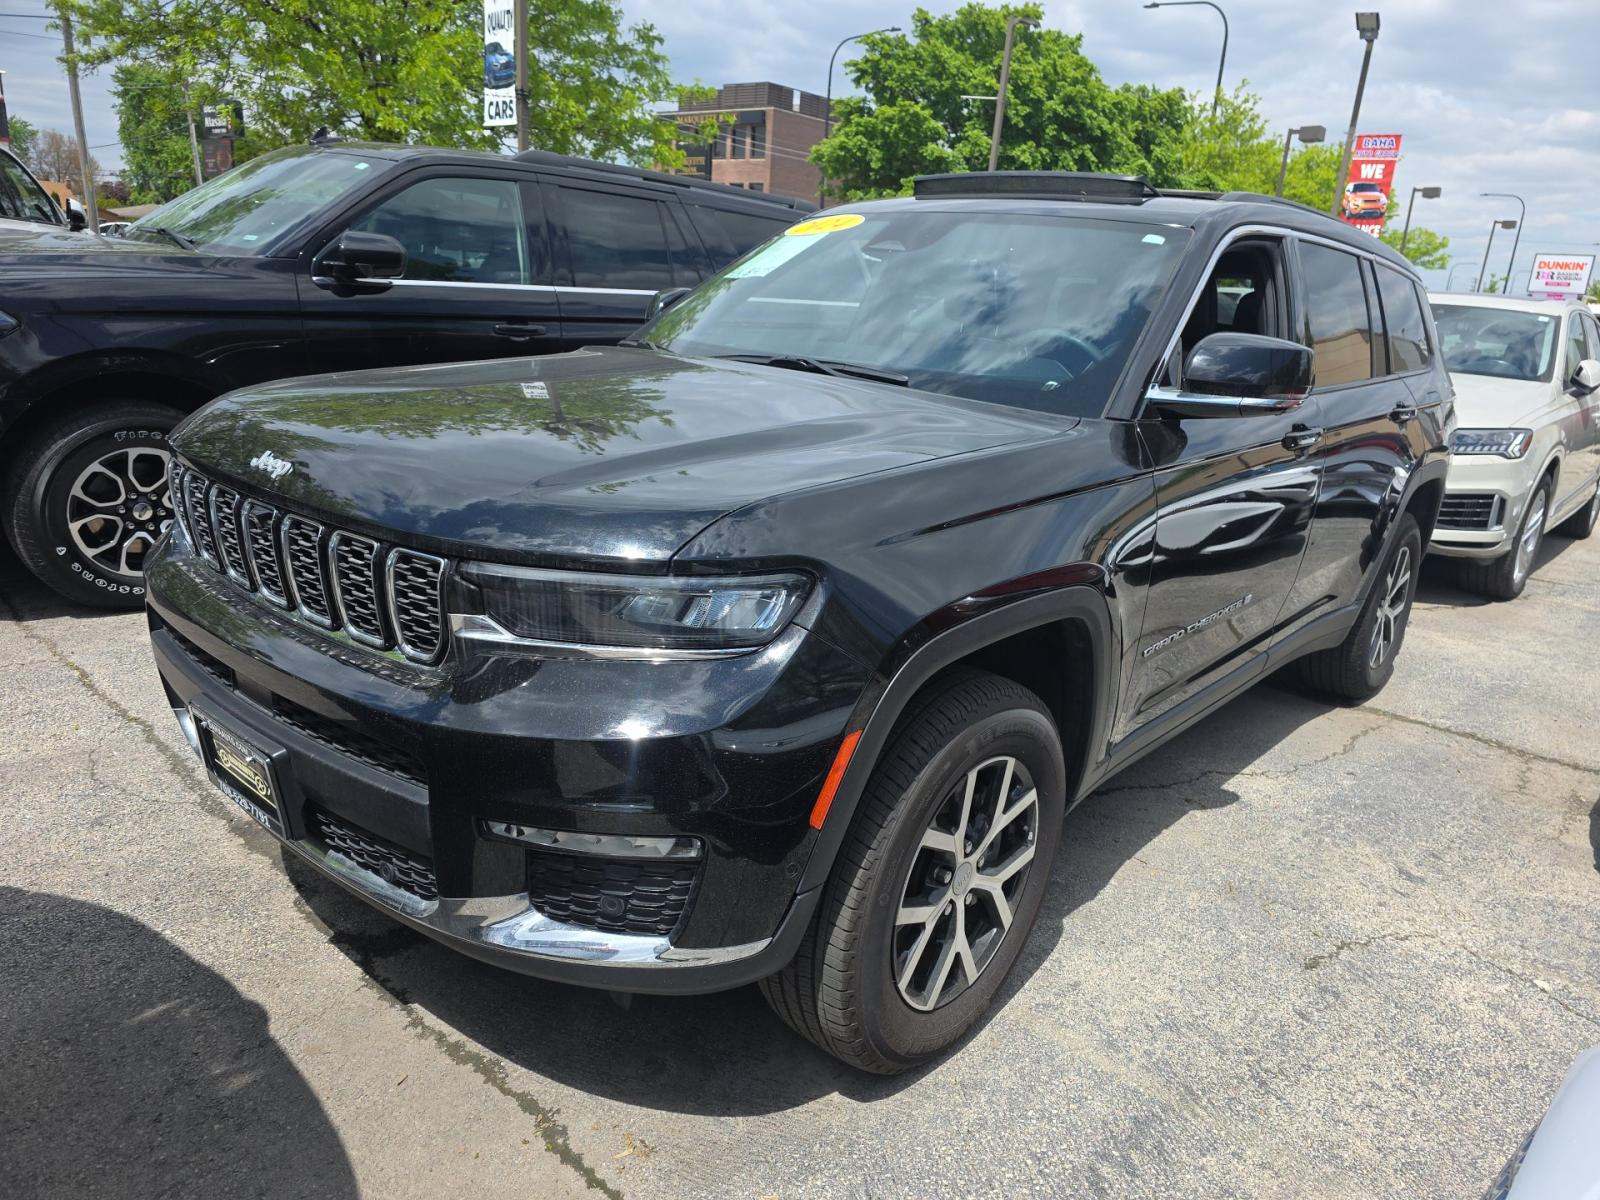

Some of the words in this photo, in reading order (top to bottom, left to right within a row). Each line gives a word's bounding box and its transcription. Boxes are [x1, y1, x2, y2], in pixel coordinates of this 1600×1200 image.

[488, 99, 514, 120] CARS
[1360, 163, 1386, 179] WE
[250, 450, 293, 480] Jeep
[1143, 629, 1186, 658] GRAND
[1187, 599, 1243, 633] CHEROKEE
